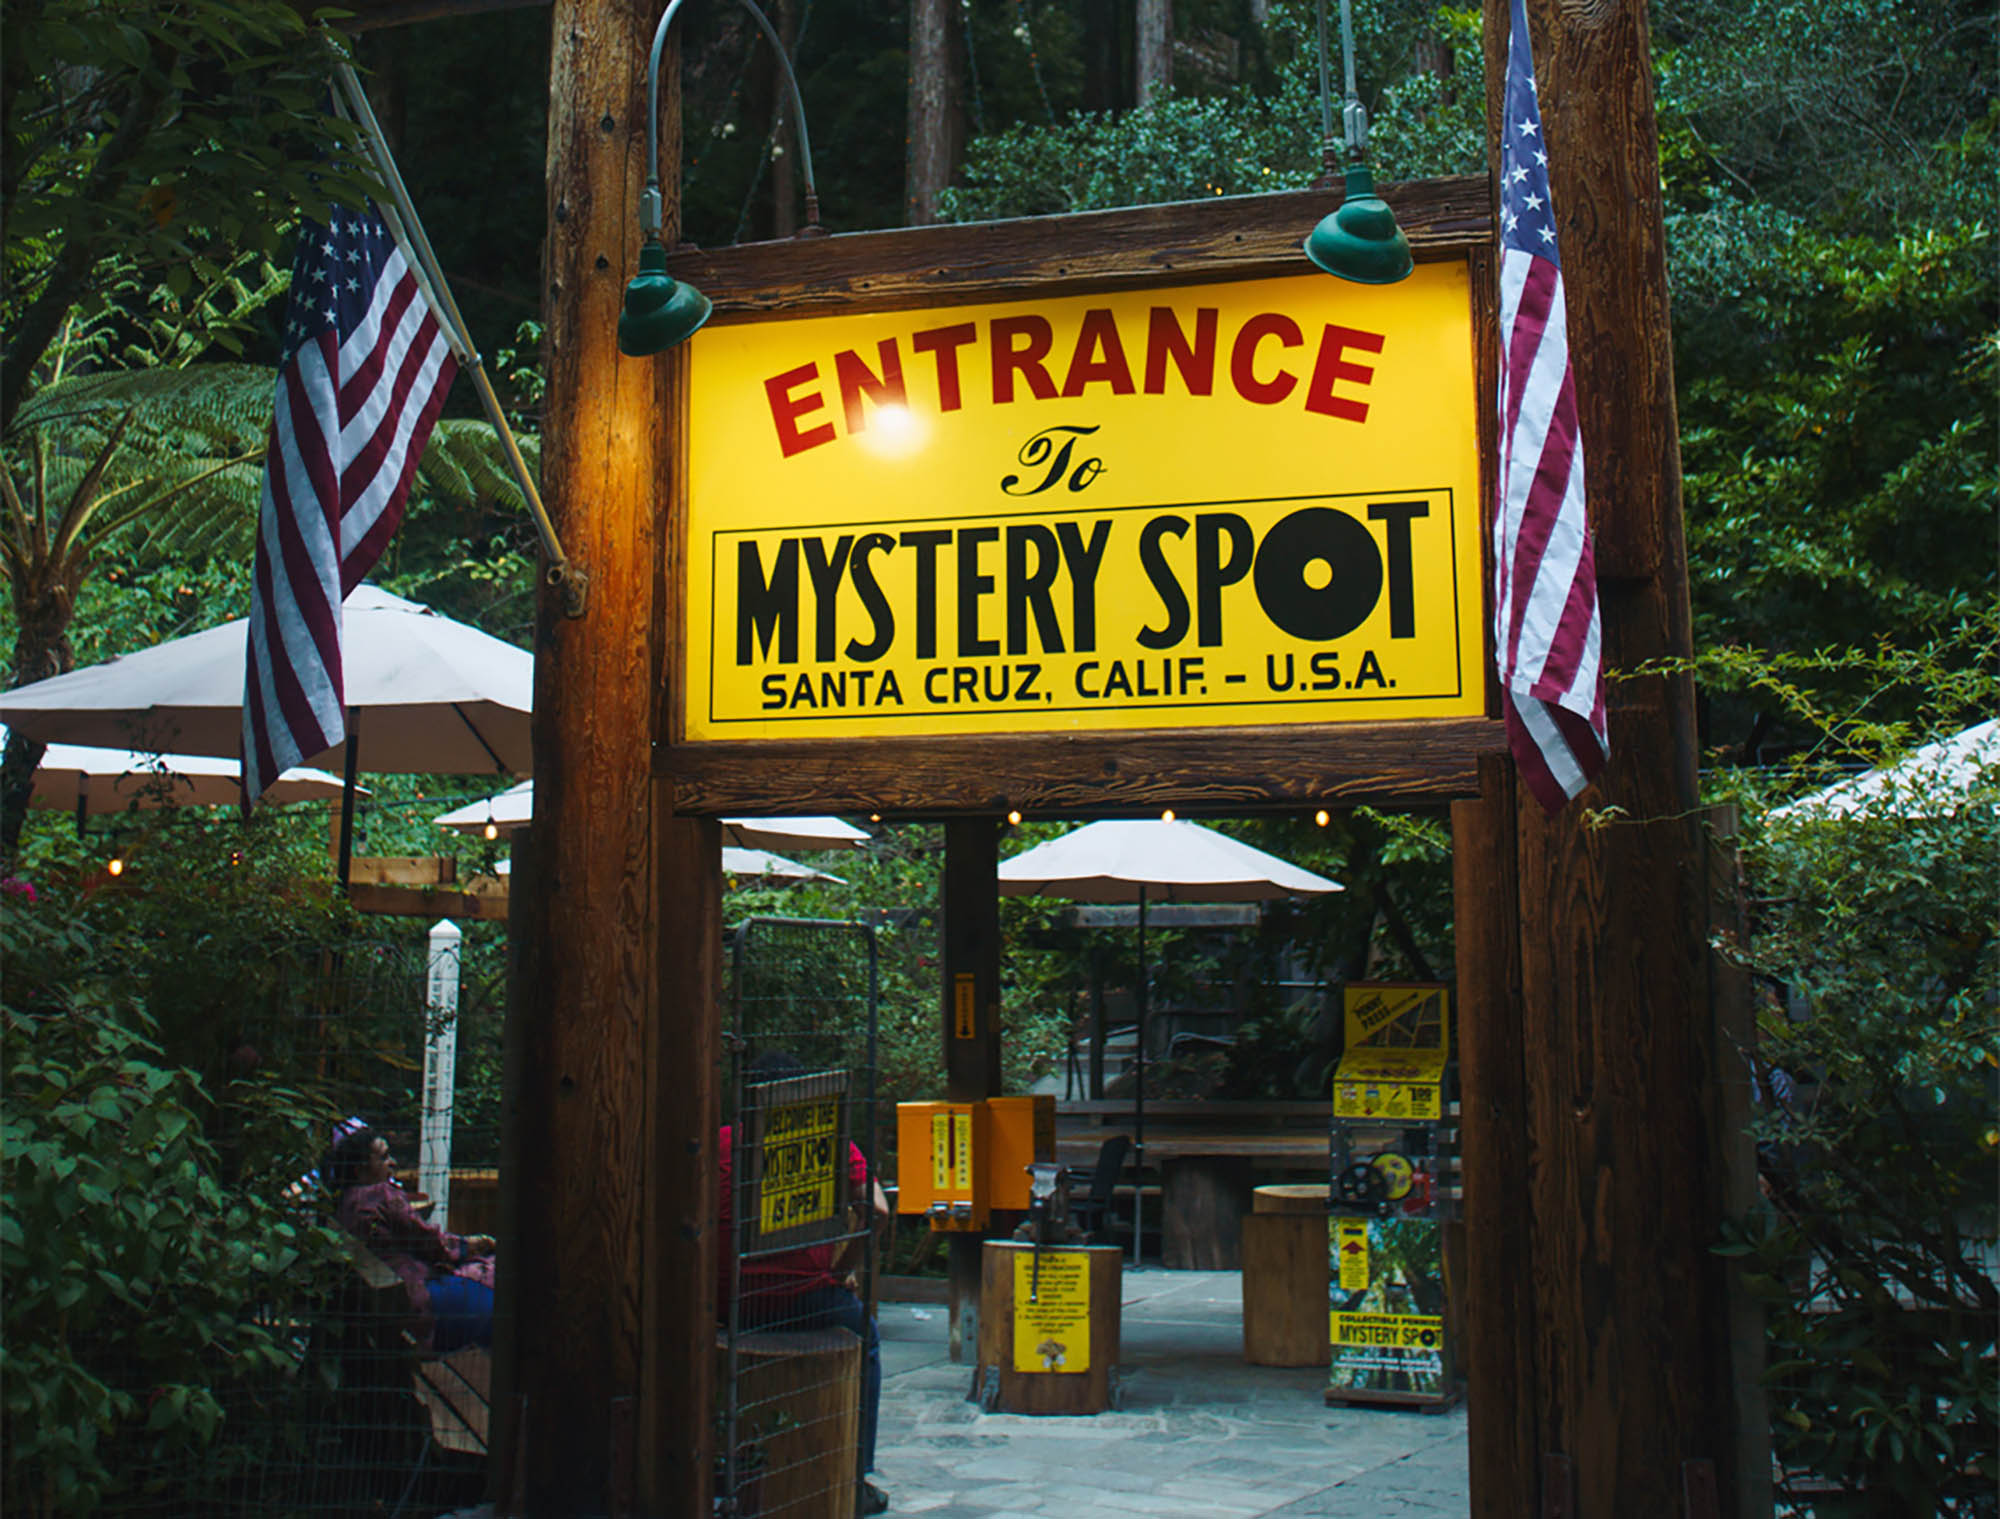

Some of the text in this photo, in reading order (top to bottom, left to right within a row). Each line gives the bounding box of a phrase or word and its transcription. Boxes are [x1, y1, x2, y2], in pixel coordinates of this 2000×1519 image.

[764, 306, 1386, 457] ENTRANCE
[1001, 424, 1106, 496] To
[736, 500, 1430, 666] MYSTERY SPOT
[761, 670, 904, 710] SANTA
[924, 663, 1054, 704] CRUZ,
[1075, 657, 1207, 698] CALIF.
[1266, 650, 1396, 692] U.S.A.
[787, 1189, 822, 1219] OPEN
[1339, 1325, 1442, 1347] MYSTERY SPOT
